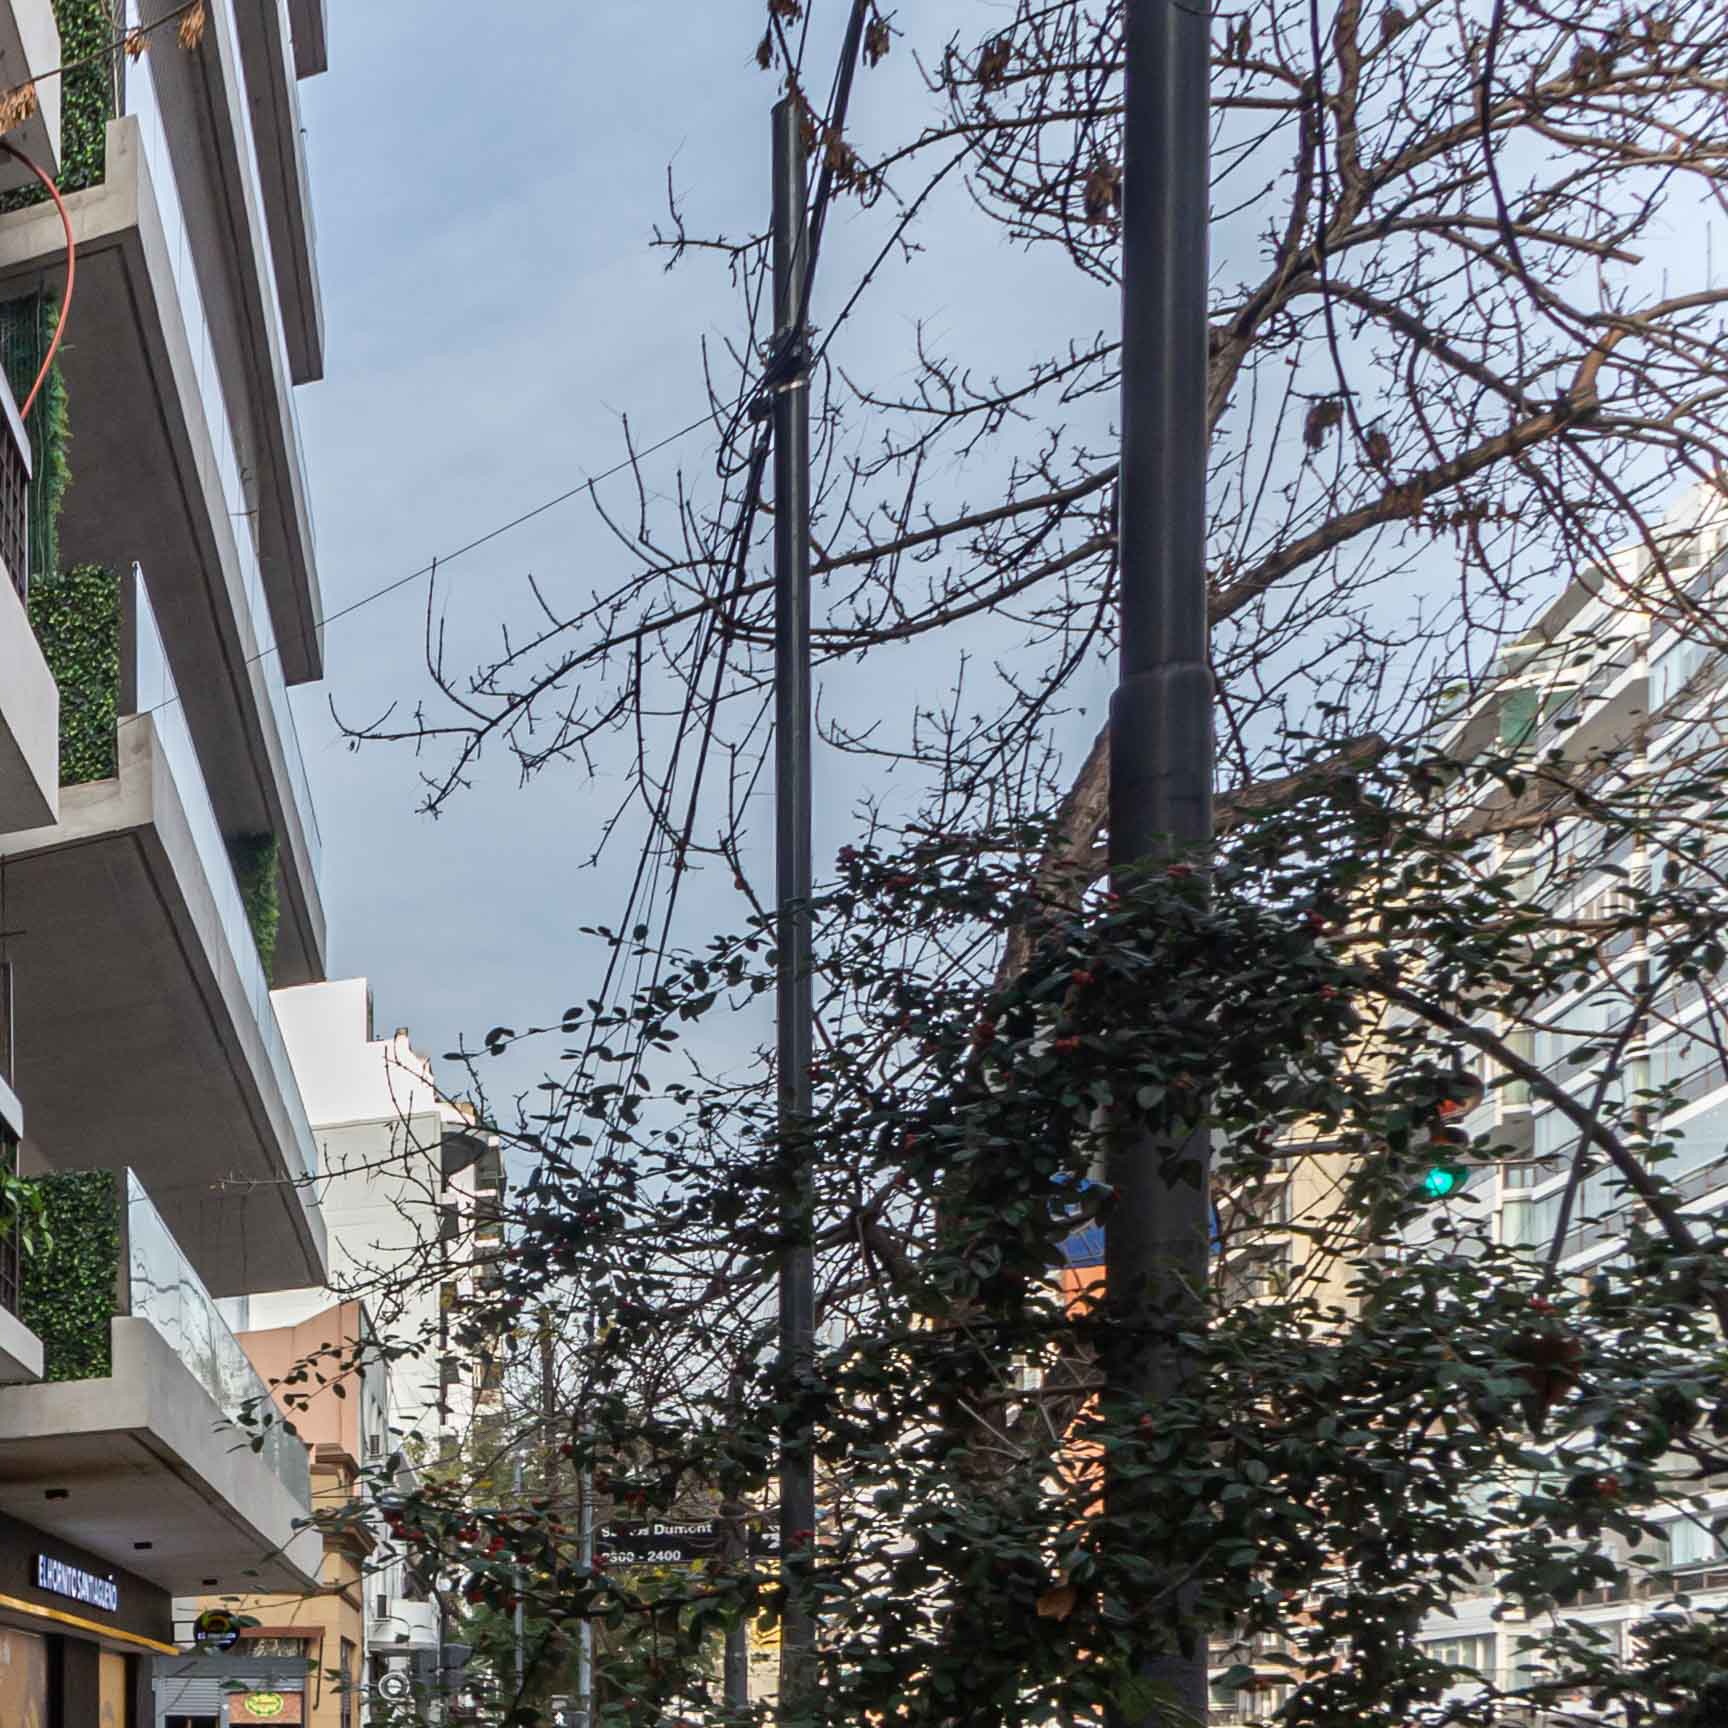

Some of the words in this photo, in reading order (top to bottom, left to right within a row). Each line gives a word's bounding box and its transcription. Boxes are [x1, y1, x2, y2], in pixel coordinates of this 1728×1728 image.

[601, 1526, 650, 1537] Sos
[653, 1523, 713, 1536] Dumont
[647, 1550, 682, 1562] 2400
